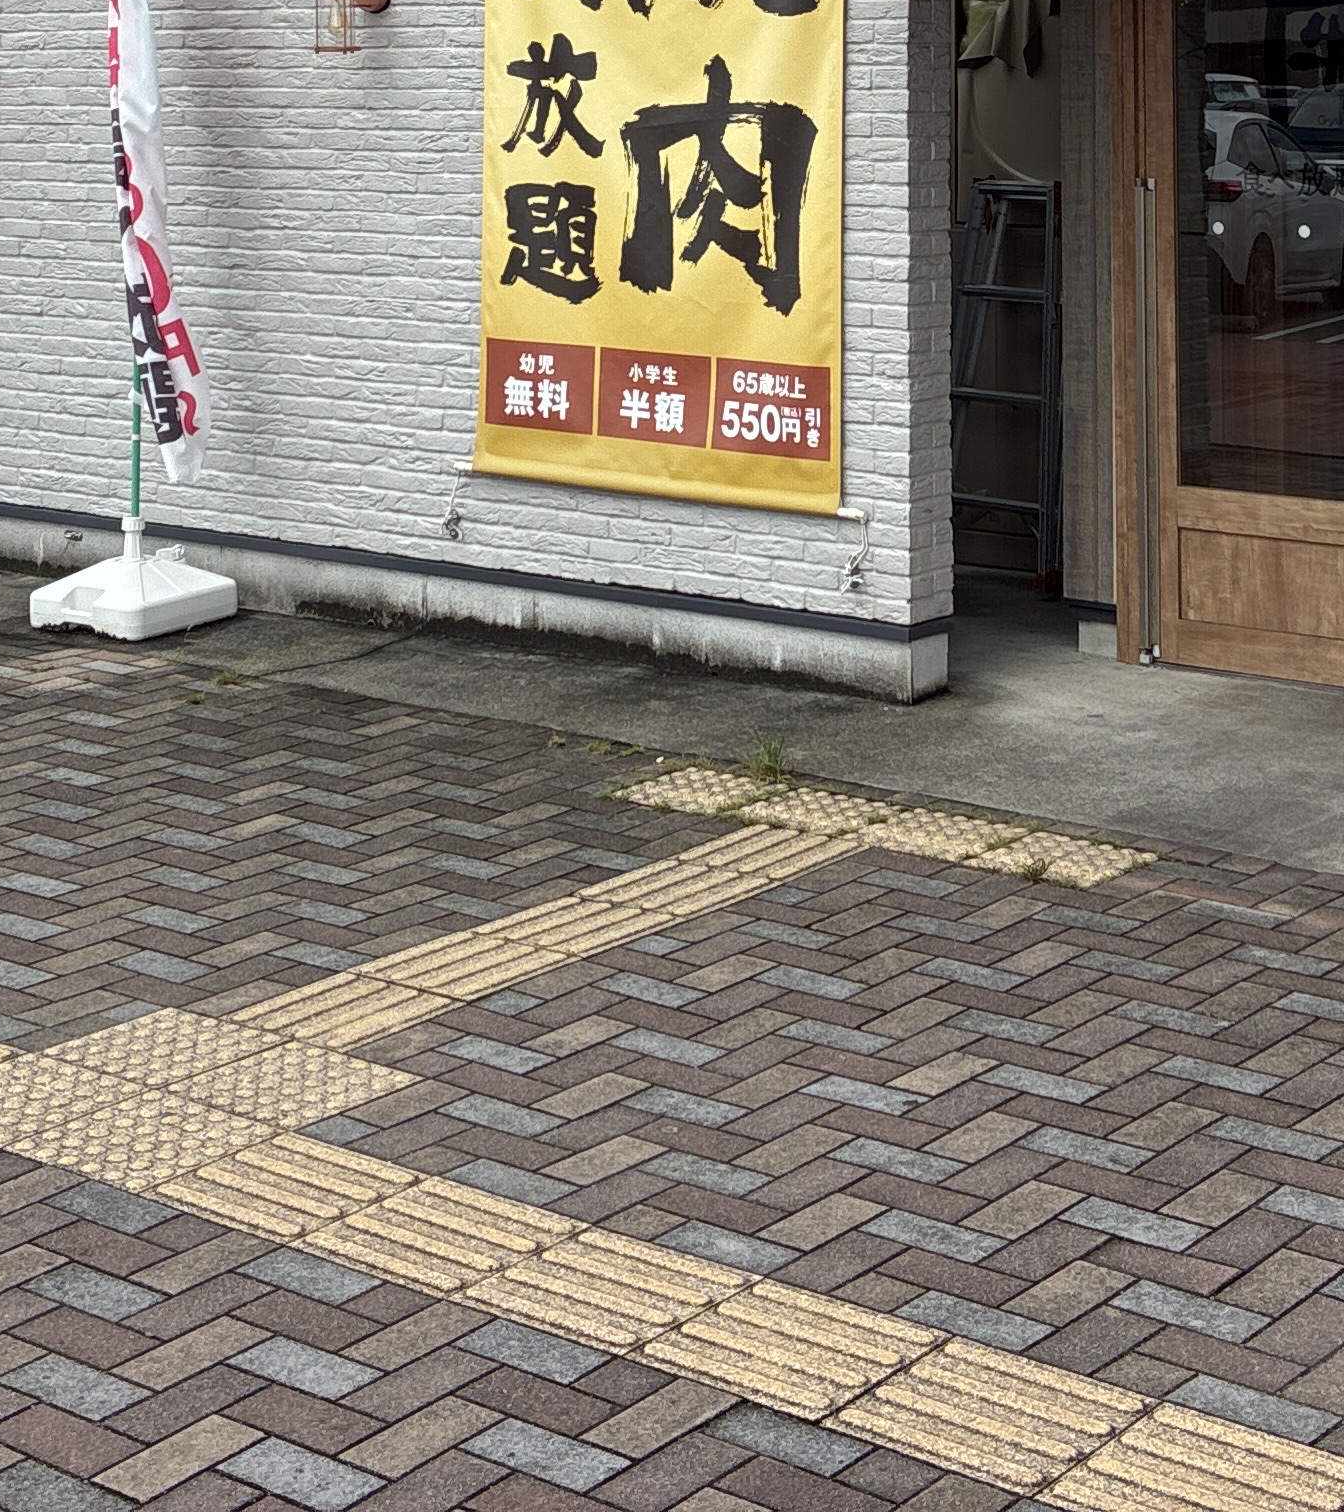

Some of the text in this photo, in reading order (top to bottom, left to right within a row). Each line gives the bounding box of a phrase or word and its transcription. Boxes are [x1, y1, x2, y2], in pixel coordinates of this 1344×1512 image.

[518, 352, 555, 375] 幼児
[628, 363, 679, 386] 小学生
[503, 376, 570, 421] 無料
[732, 370, 807, 399] 65歳以上
[619, 389, 686, 434] 半額
[720, 400, 801, 444] 550円
[805, 408, 821, 448] 引き
